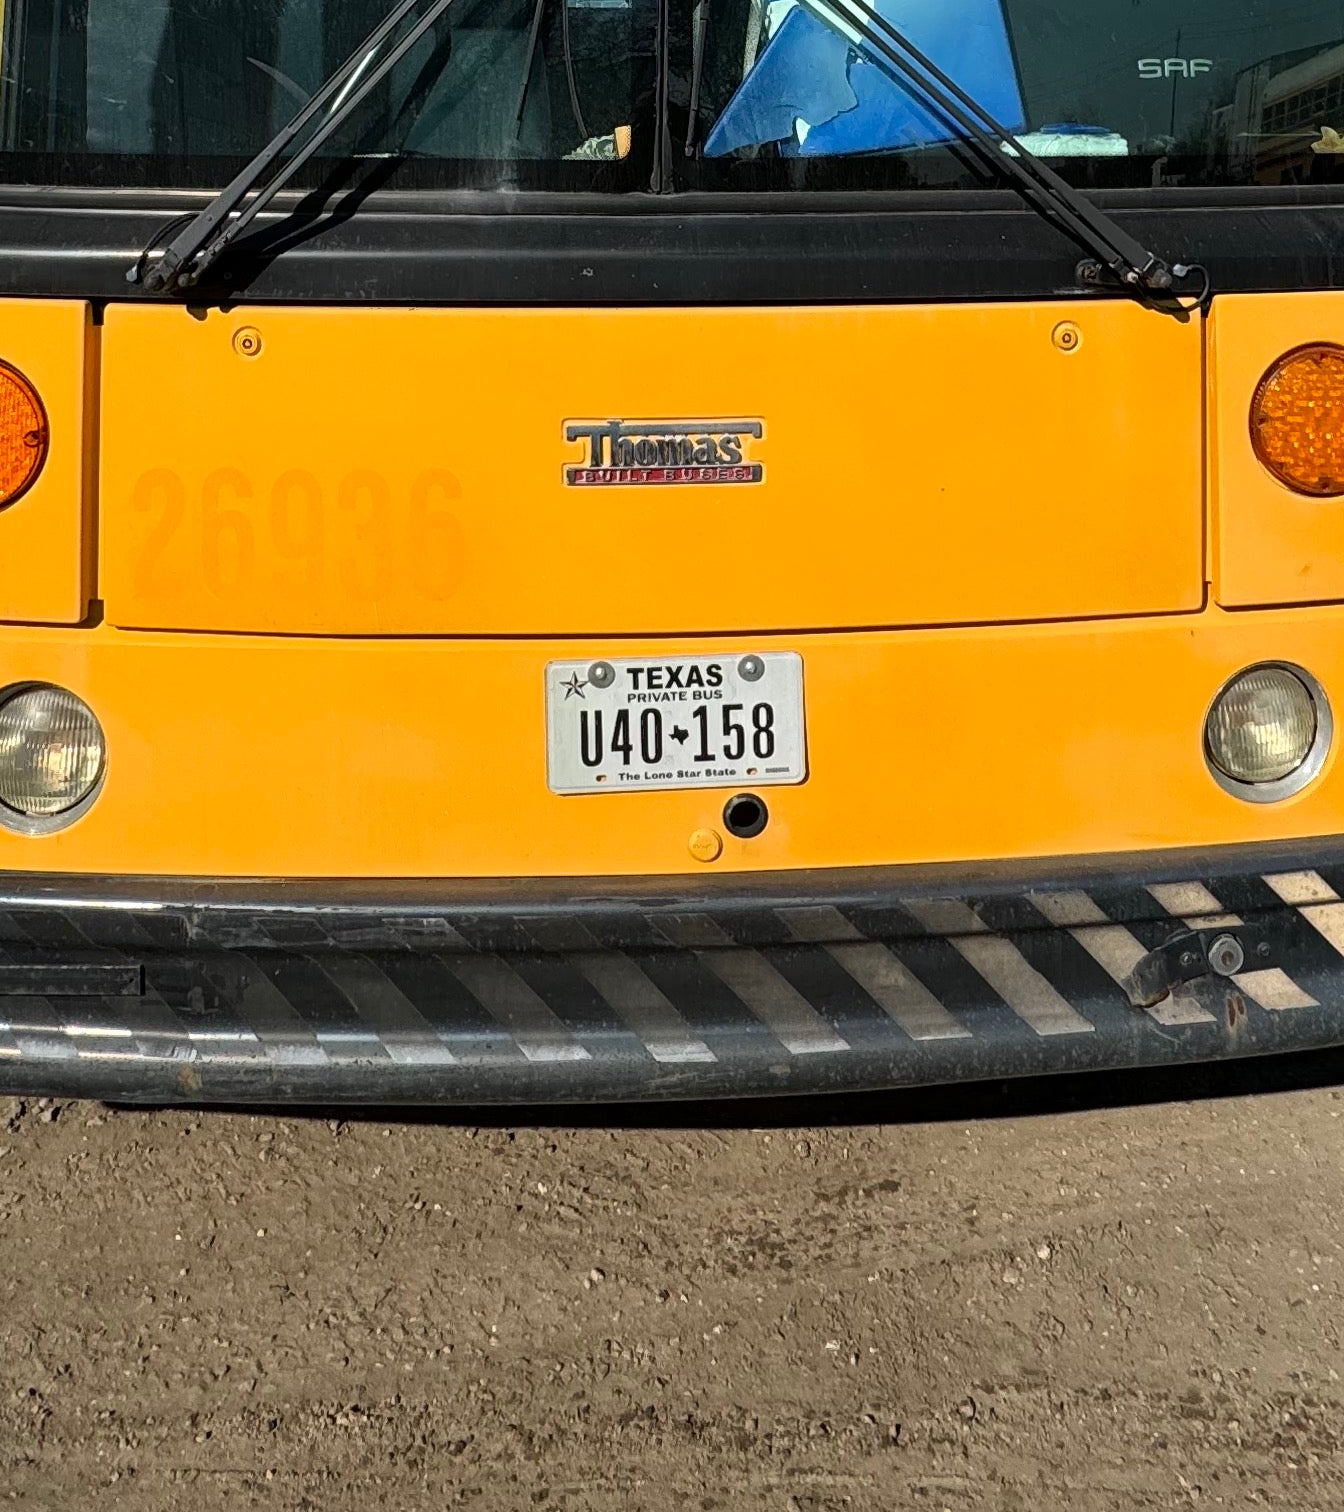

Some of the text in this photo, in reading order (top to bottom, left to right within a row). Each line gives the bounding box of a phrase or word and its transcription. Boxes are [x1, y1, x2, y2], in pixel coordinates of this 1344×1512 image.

[566, 419, 762, 467] Thomas
[582, 468, 746, 482] BUILT BUSES
[132, 467, 465, 602] 26936
[626, 664, 723, 690] TEXAS
[627, 689, 723, 703] PRIVATE BUS
[618, 768, 736, 781] The Lone Star State
